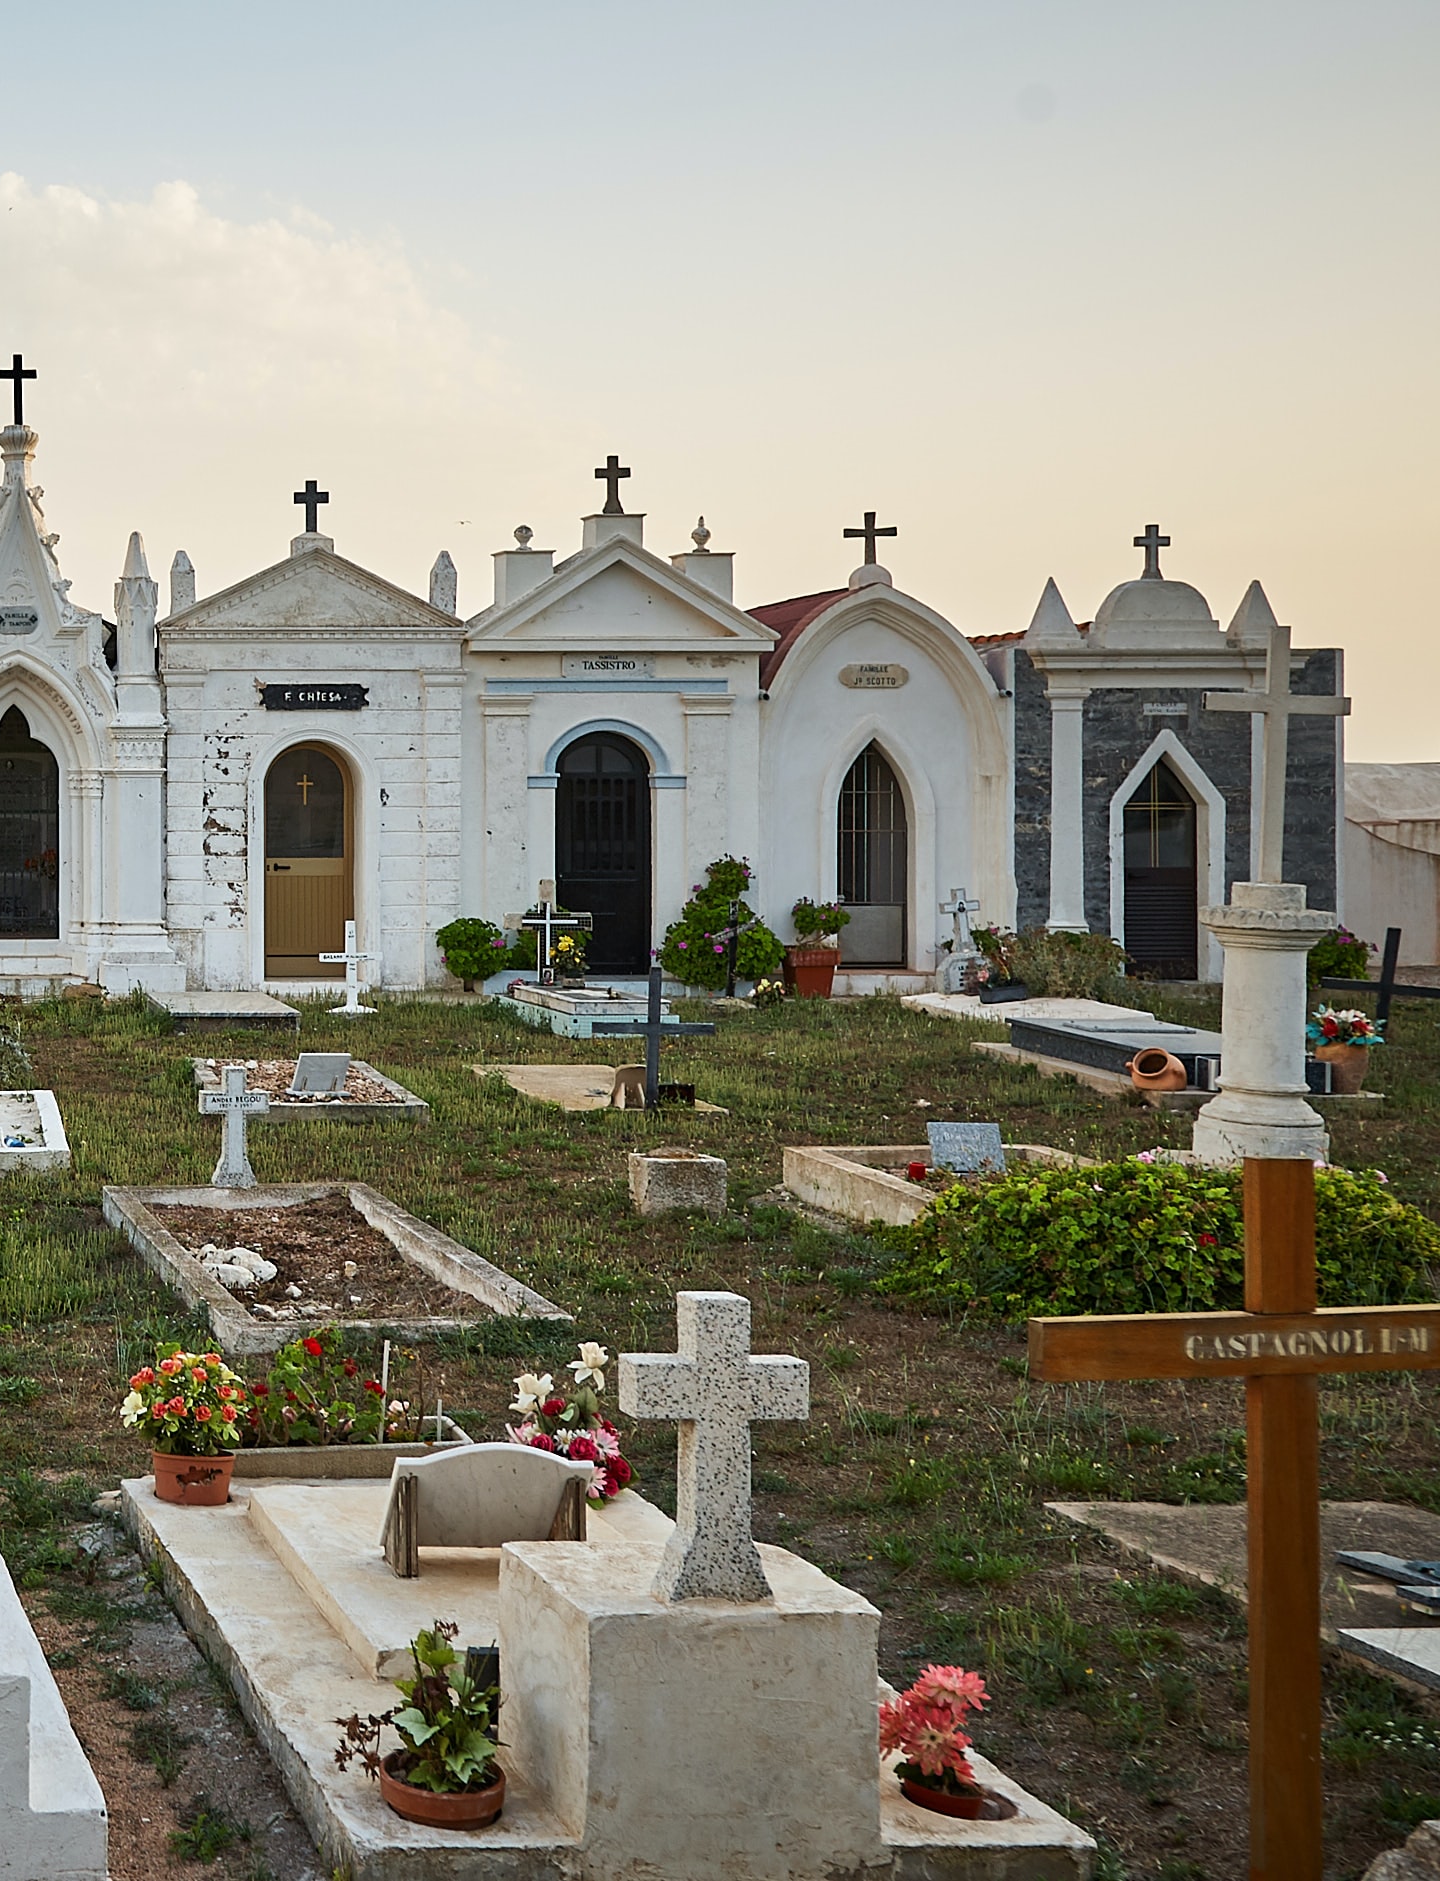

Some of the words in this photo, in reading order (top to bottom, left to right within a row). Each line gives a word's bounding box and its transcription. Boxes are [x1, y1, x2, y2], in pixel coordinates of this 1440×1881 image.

[581, 660, 636, 670] TASSISTRO
[860, 665, 889, 673] FAMILLE
[866, 677, 896, 686] SCOTTO
[235, 1095, 262, 1103] BEGOU
